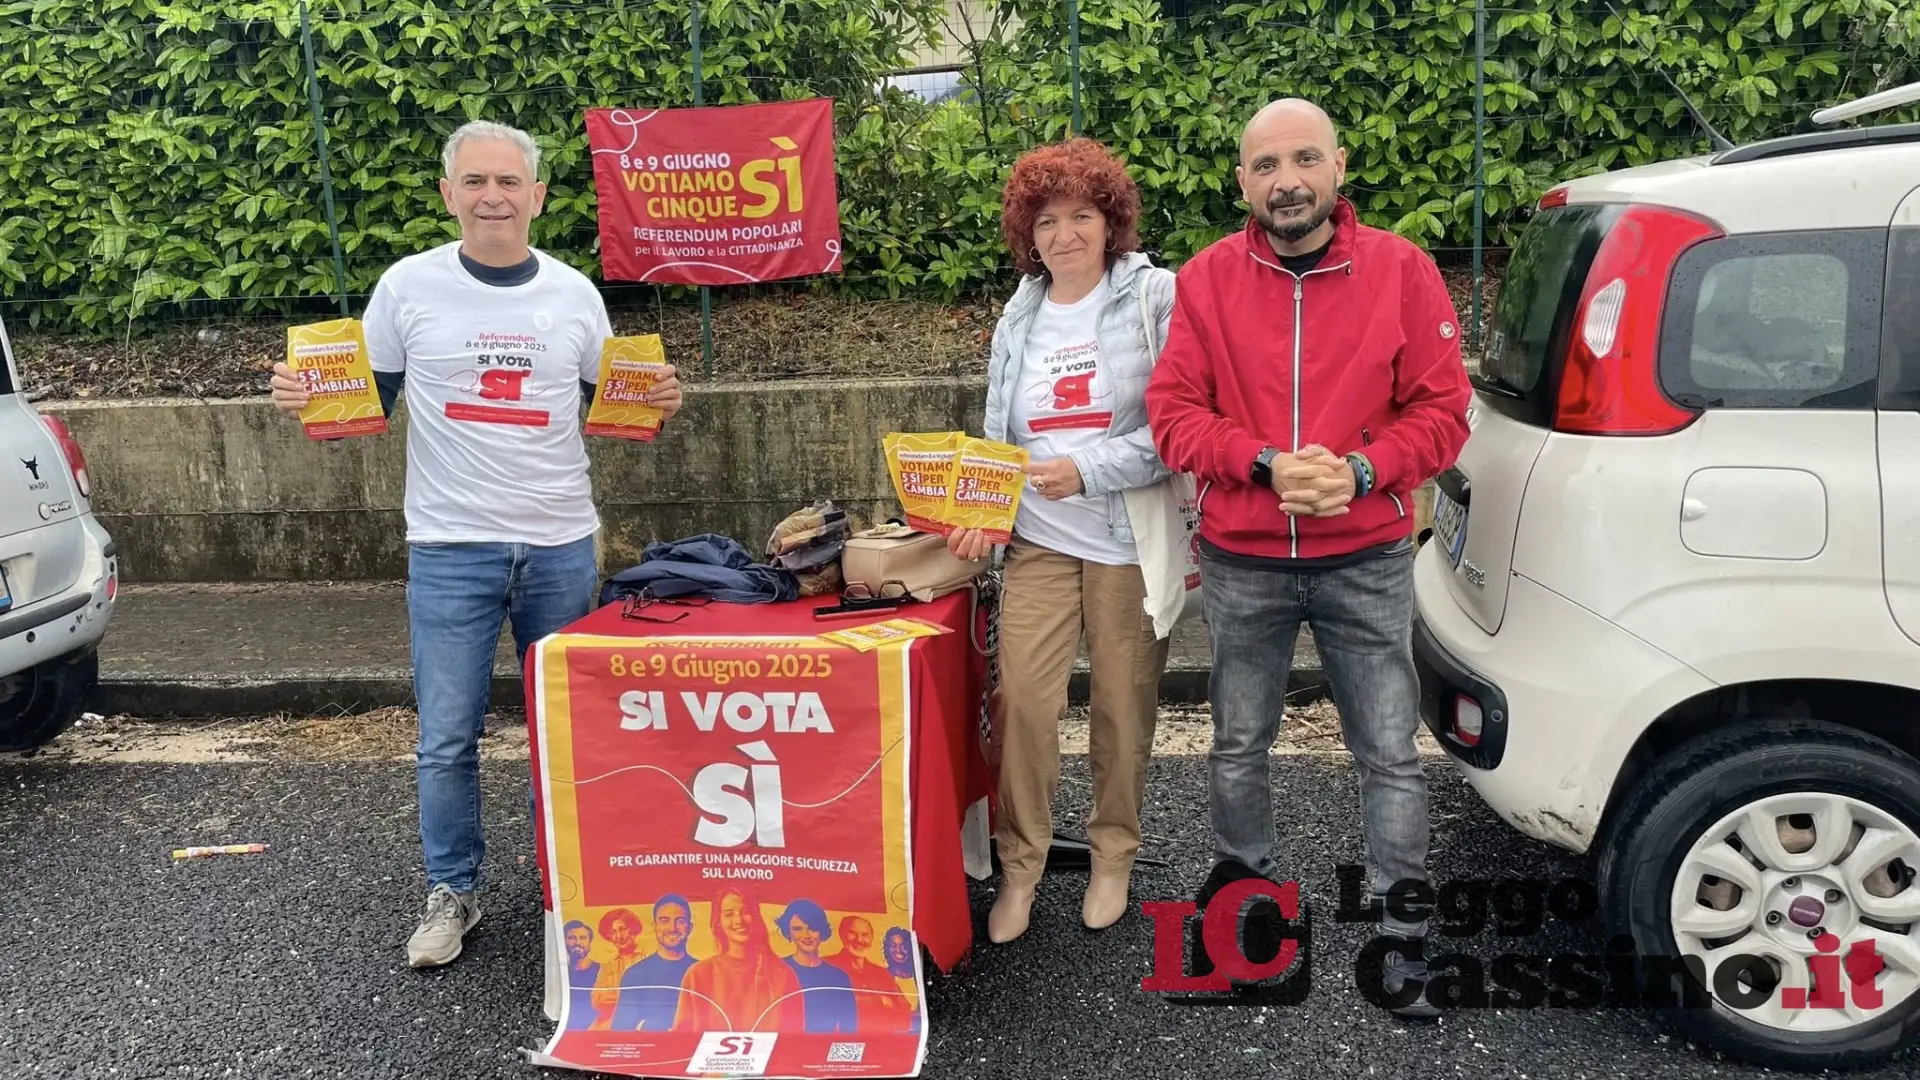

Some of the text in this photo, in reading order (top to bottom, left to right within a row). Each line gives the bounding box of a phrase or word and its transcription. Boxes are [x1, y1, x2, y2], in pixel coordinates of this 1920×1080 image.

[620, 152, 731, 171] 8 e 9 GIUGNO
[620, 170, 735, 193] VOTIAMO
[738, 136, 803, 219] SÌ
[647, 195, 738, 223] CINQUE
[633, 219, 802, 243] REFERENDUM POPOLARI
[635, 237, 804, 258] per il LAVORO e la CITTADINANZA
[479, 333, 536, 343] Referendum
[465, 340, 472, 348] 8
[482, 341, 488, 349] 9
[489, 341, 522, 350] giugno
[524, 342, 547, 352] 2025
[296, 353, 355, 368] VOTIAMO
[477, 354, 533, 368] SI VOTA
[1066, 360, 1097, 372] VOTA
[298, 371, 306, 382] 5
[323, 368, 348, 379] PER
[303, 378, 368, 394] CAMBIARE
[606, 380, 613, 390] 5
[628, 382, 648, 391] PER
[309, 393, 339, 401] AVVERO
[603, 391, 647, 402] CAMBIA
[900, 461, 953, 472] VOTIAMO
[961, 466, 1013, 481] VOTIAMO
[902, 473, 908, 482] 5
[923, 474, 944, 484] PER
[958, 479, 964, 489] 5
[980, 480, 1000, 491] PER
[904, 484, 948, 497] CAMBIA
[956, 490, 1013, 505] CAMBIARE
[610, 653, 832, 685] 8 e 9 Giugno 2025
[619, 691, 835, 733] SI VOTA
[693, 740, 785, 848] SÌ
[609, 854, 859, 874] PER GARANTIRE UNA MAGGIORE SICUREZZA
[702, 867, 774, 880] SUL LAVORO
[714, 1036, 754, 1055] Sì
